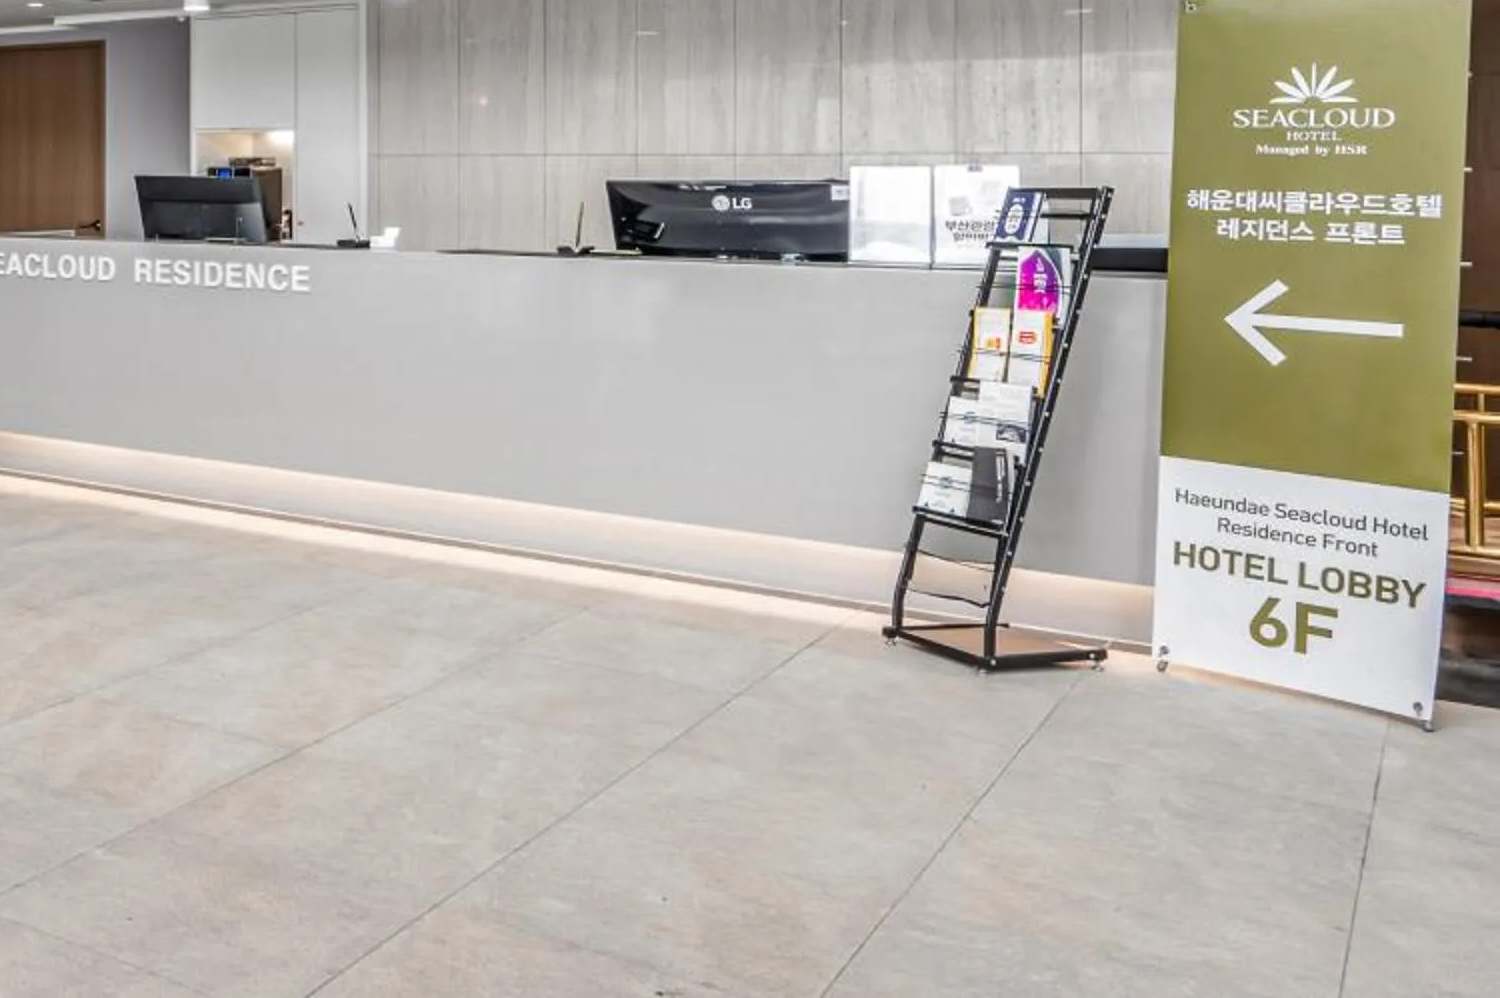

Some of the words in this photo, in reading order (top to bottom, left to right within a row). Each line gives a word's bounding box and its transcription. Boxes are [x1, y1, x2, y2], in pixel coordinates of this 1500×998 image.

[1232, 107, 1396, 129] SEACLOUD
[1255, 144, 1309, 157] Managed
[1315, 145, 1329, 157] by
[1286, 130, 1343, 142] HOTEL
[732, 197, 753, 210] LG
[1187, 189, 1443, 219] 해운대씨클라우드호텔
[1217, 218, 1316, 242] 레지던스
[1324, 222, 1406, 246] 프론트
[134, 258, 311, 292] RESIDENCE
[1175, 488, 1270, 517] Haeundae
[1274, 503, 1367, 531] Seacloud
[1372, 517, 1429, 541] Hotel
[1217, 517, 1317, 548] Residence
[1322, 534, 1379, 558] Front
[1173, 541, 1288, 586] HOTEL
[1298, 561, 1427, 609] LOBBY
[1250, 596, 1339, 655] 6F
